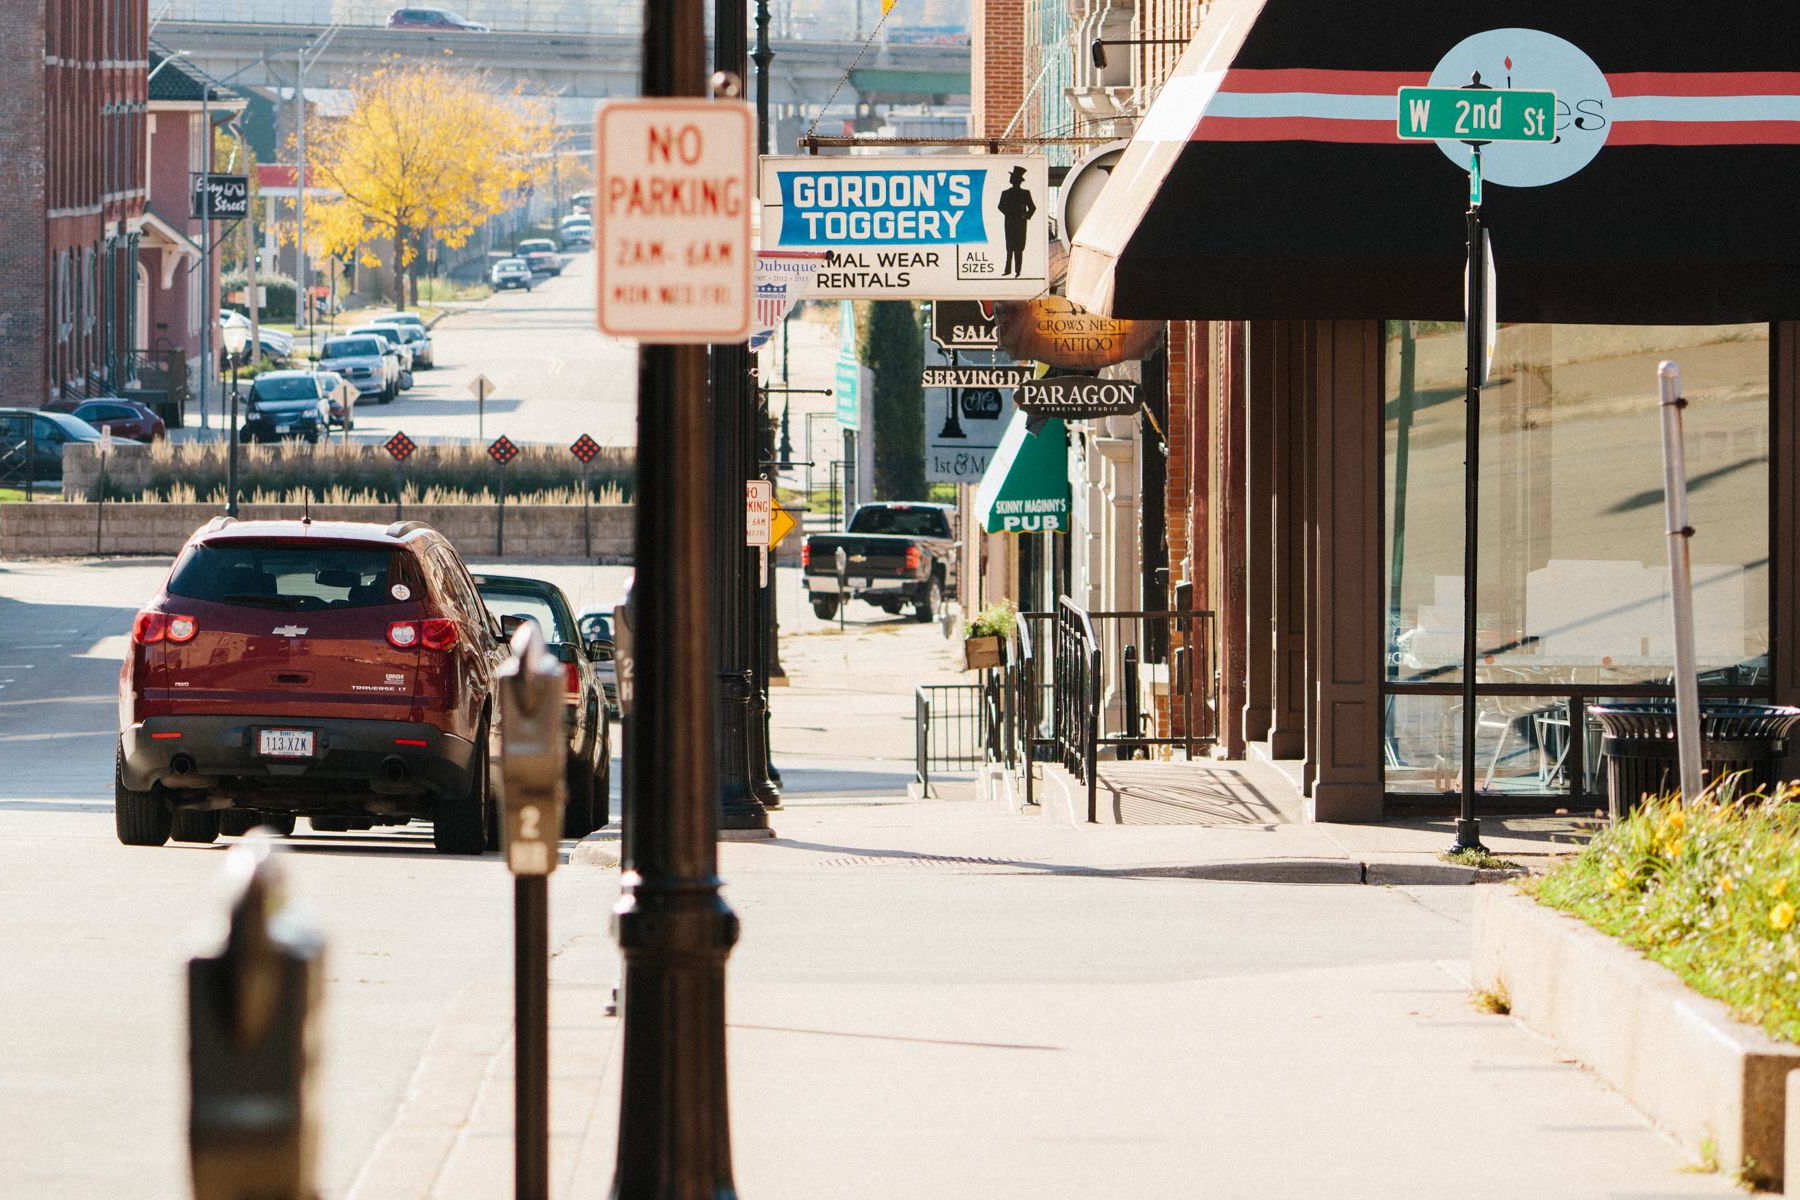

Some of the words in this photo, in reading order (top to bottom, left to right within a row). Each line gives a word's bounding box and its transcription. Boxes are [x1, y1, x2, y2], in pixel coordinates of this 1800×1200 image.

[1409, 99, 1430, 133] W
[1454, 96, 1502, 134] 2nd
[1523, 107, 1545, 136] St
[648, 125, 703, 164] NO
[196, 177, 223, 197] Esy
[793, 172, 970, 208] GORDON'S
[214, 196, 247, 212] Street
[608, 176, 741, 217] PARKING
[802, 211, 964, 240] TOGGERY
[821, 253, 870, 268] MAL
[878, 252, 939, 268] WEAR
[966, 252, 989, 262] ALL
[755, 260, 817, 275] Dubuque
[962, 263, 994, 273] SIZES
[817, 272, 910, 288] RENTALS
[1052, 337, 1113, 351] TATTOO
[922, 370, 1005, 385] SERVING
[1008, 370, 1033, 385] DA
[1022, 385, 1136, 405] PARAGON
[934, 456, 951, 473] 1st
[954, 452, 969, 476] &
[971, 457, 986, 474] M
[747, 501, 768, 512] KING
[995, 500, 1024, 514] SKINNY
[1025, 499, 1066, 513] MAGINNY'S
[1003, 515, 1060, 531] PUB
[622, 657, 634, 678] 2
[621, 680, 633, 701] H
[266, 737, 284, 750] 113
[288, 737, 306, 751] XZK
